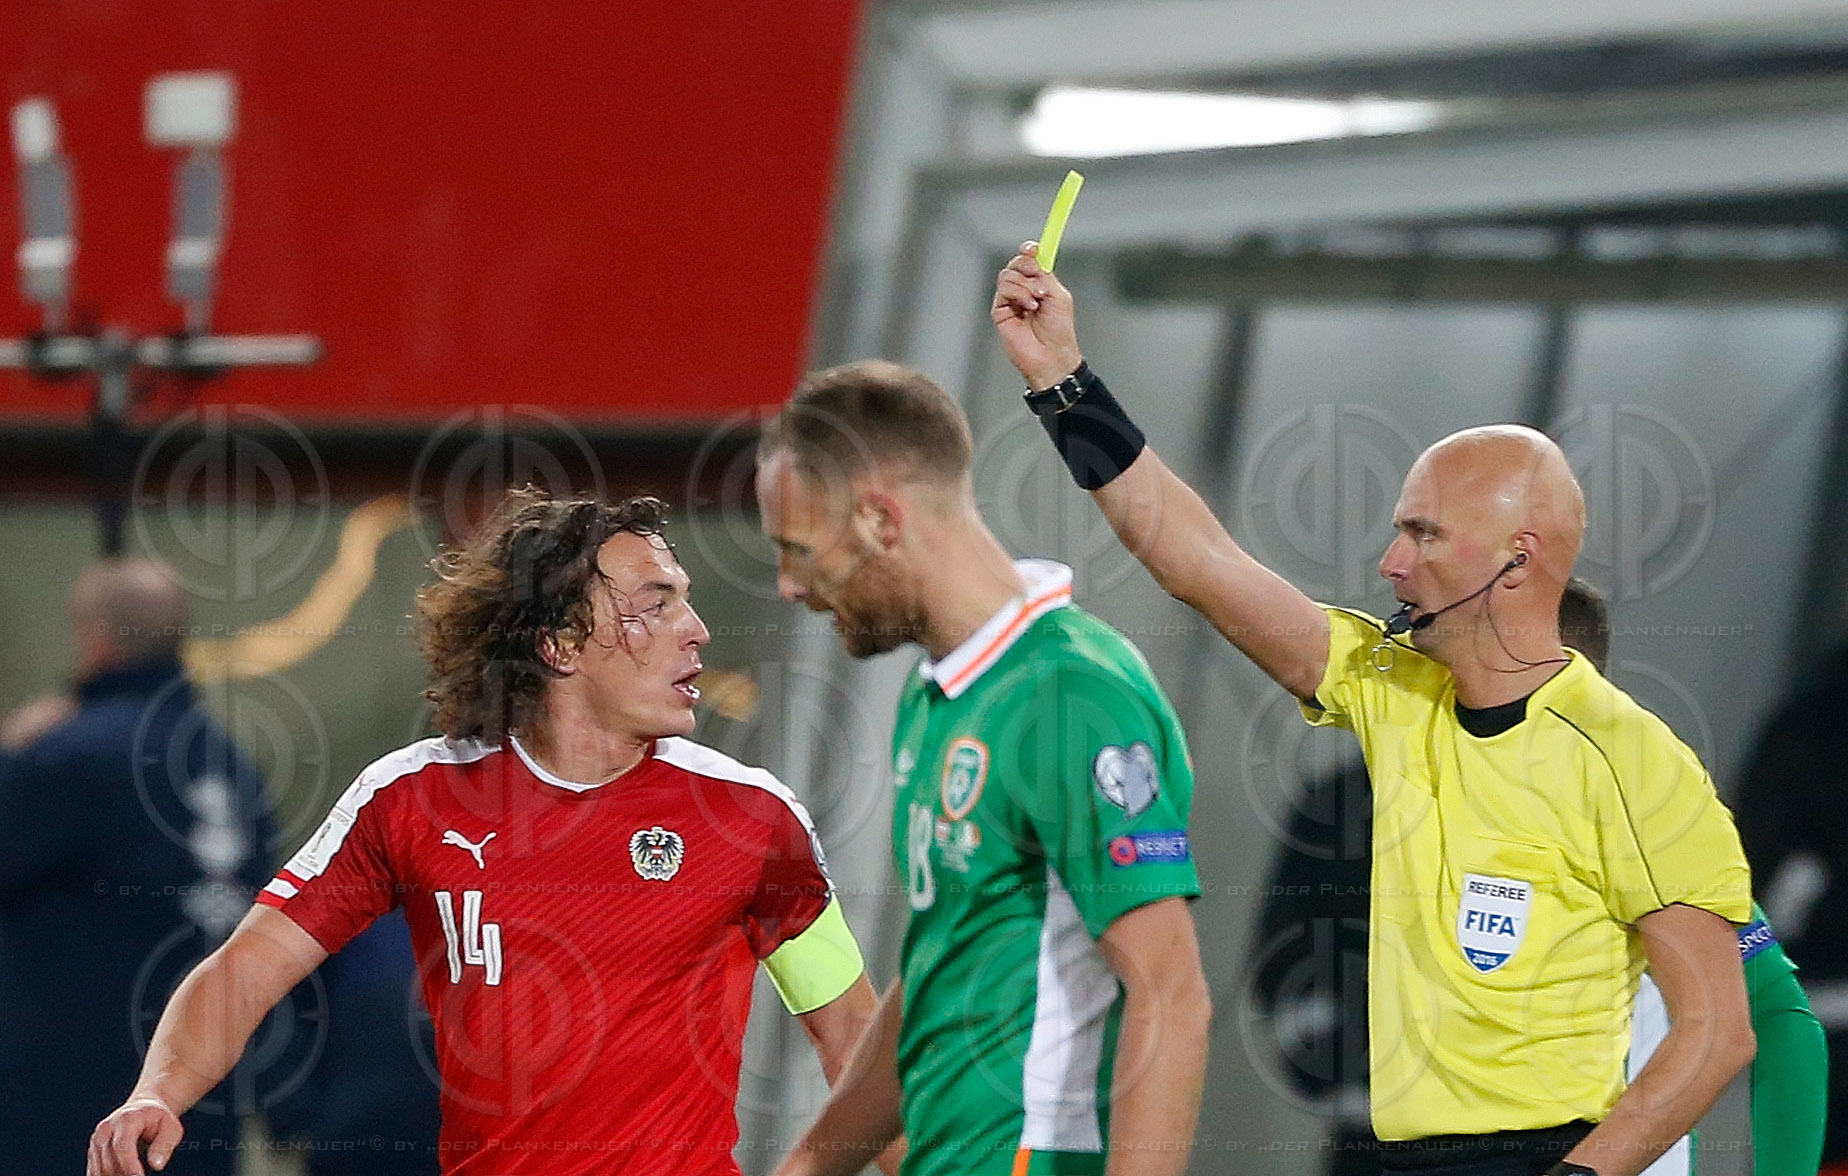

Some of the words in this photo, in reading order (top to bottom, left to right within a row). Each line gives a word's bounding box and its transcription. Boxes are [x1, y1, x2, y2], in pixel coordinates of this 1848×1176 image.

[1468, 881, 1527, 901] REFEREE
[1465, 909, 1517, 937] FIFA
[434, 890, 502, 986] 14
